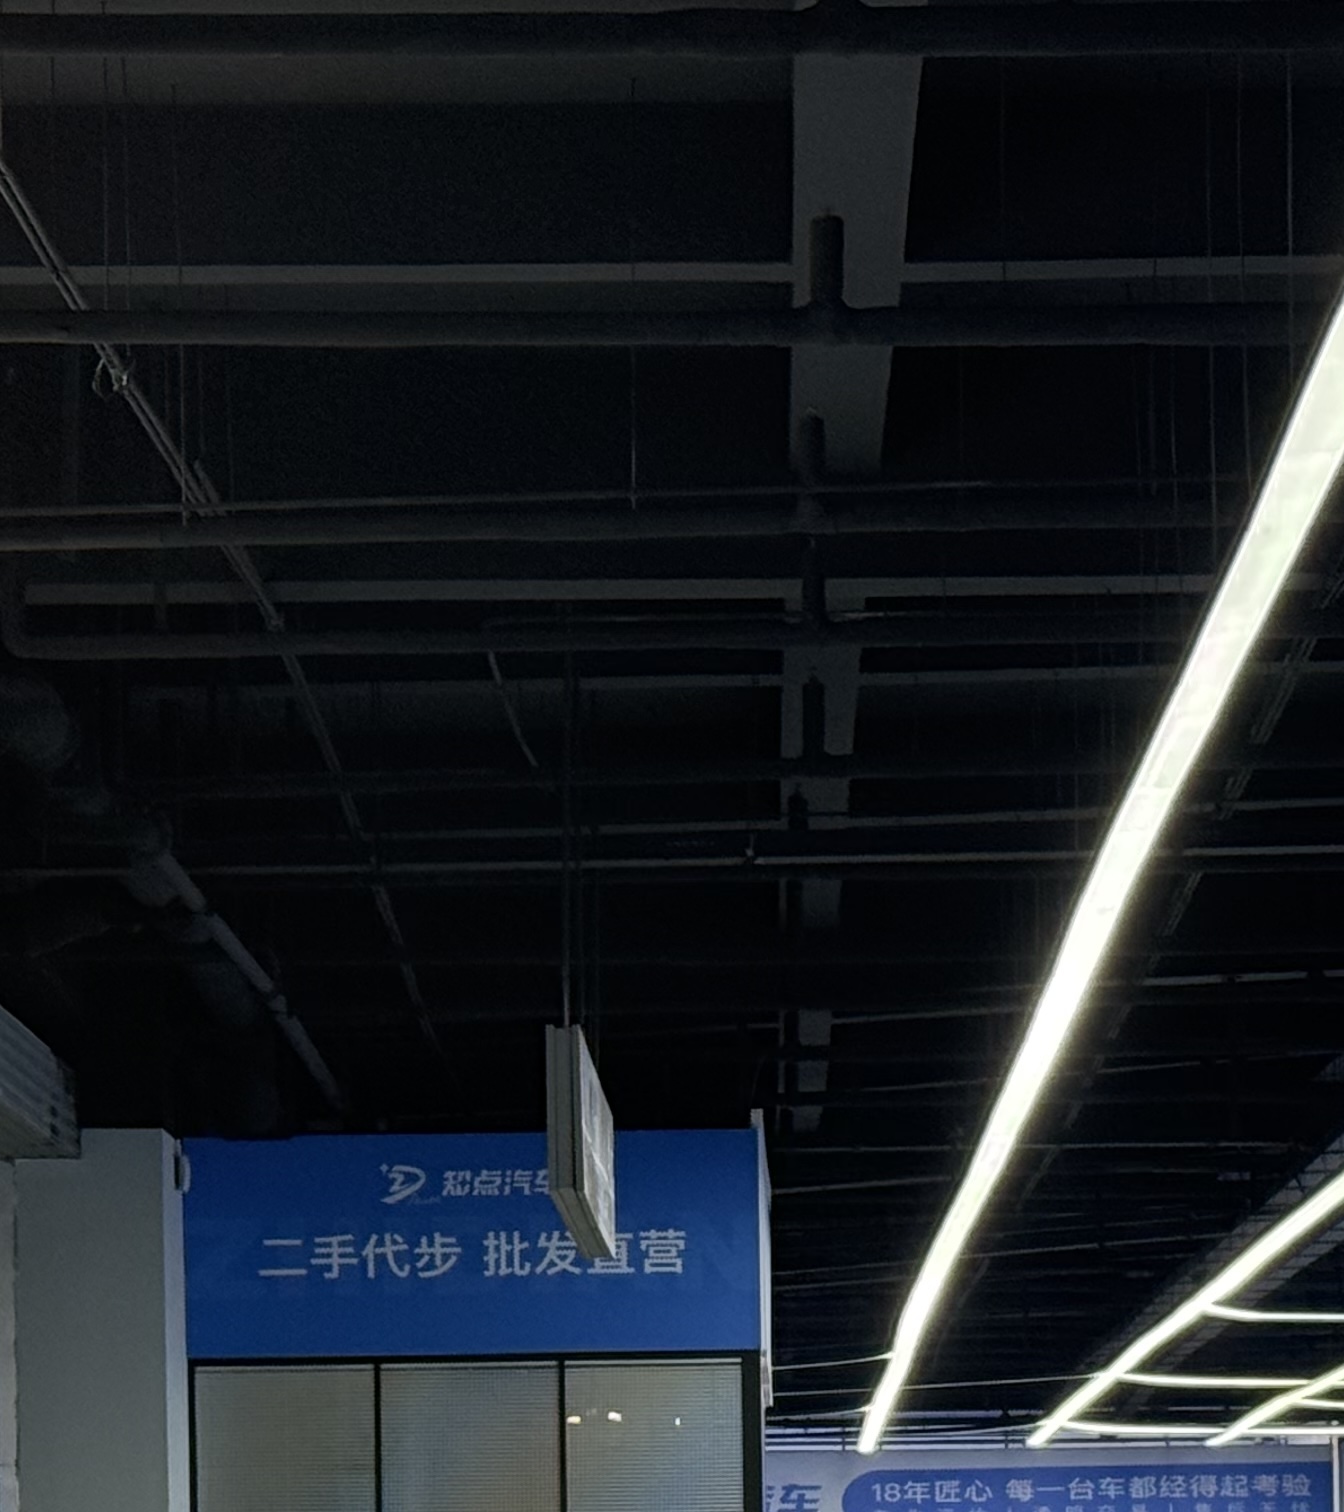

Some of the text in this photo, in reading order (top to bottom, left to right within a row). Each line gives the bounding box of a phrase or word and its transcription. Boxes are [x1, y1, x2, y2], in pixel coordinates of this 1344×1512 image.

[258, 1229, 687, 1279] 二手代步 批发直营
[872, 1474, 1312, 1504] 18年匠心 每一台车都经得起考验
